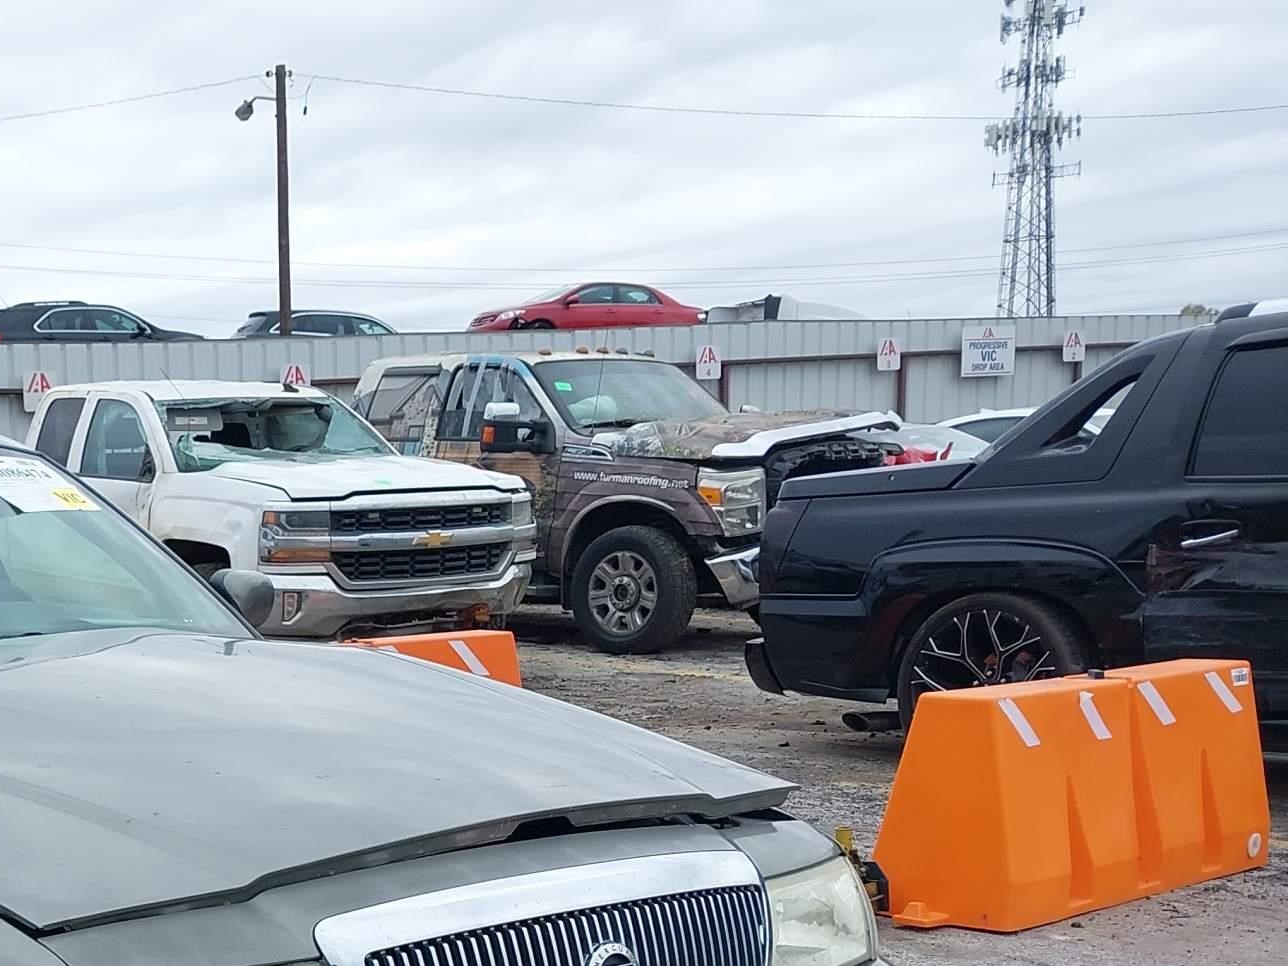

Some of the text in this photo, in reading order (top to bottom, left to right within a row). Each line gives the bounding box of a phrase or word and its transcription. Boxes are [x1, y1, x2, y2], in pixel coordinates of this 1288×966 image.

[968, 341, 1009, 350] PROGRESSIVE
[980, 350, 997, 362] VIC
[971, 362, 1005, 372] DROP AREA
[573, 471, 690, 489] www.furmanroofing.net
[51, 490, 88, 504] VIC
